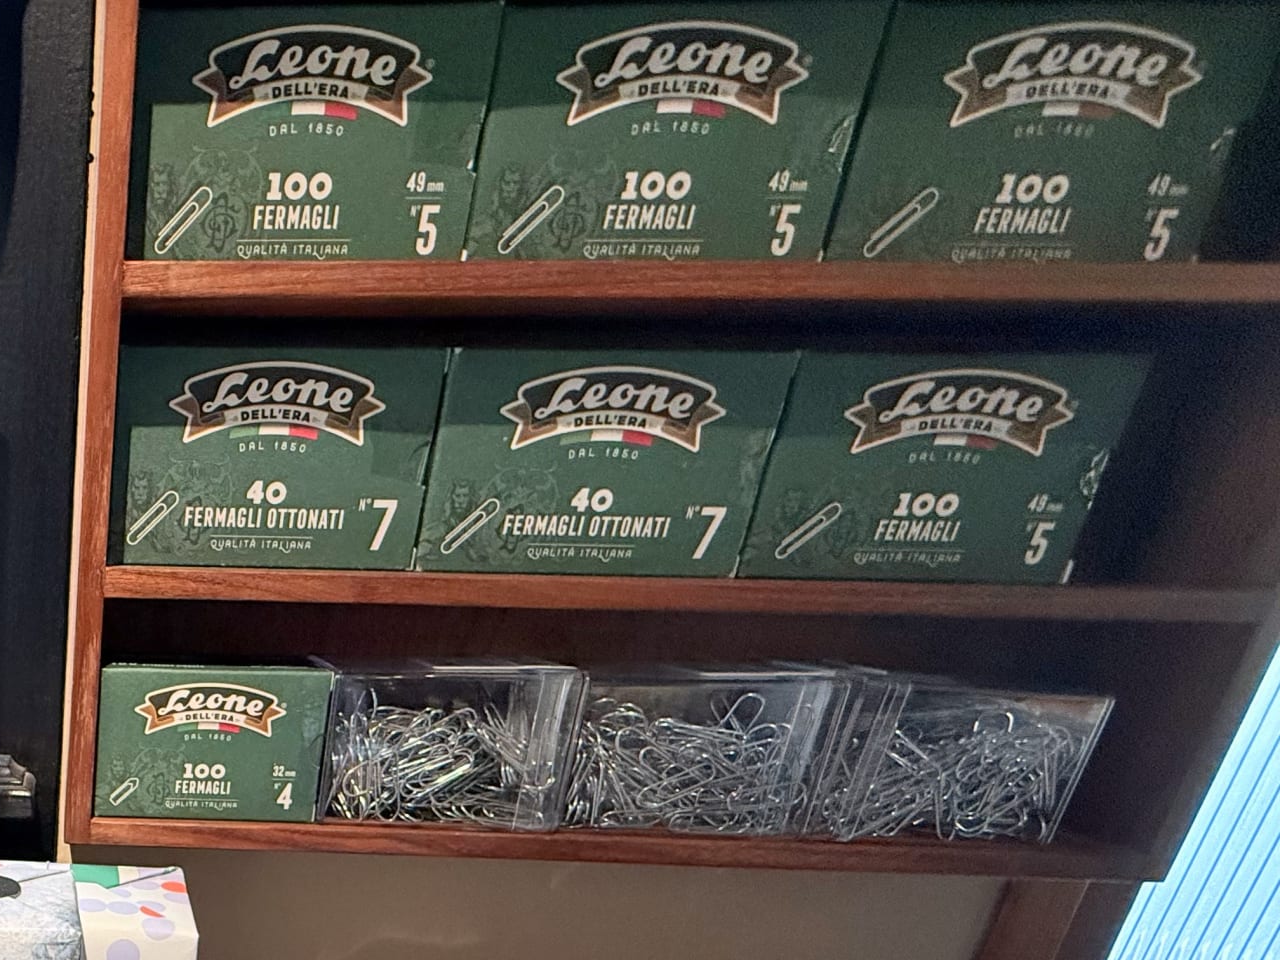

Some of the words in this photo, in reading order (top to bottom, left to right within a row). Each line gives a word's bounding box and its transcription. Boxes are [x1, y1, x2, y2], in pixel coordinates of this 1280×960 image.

[229, 39, 397, 90] Leone
[594, 37, 772, 88] Leone
[982, 37, 1168, 89] Leone
[271, 82, 349, 99] DELL'ERA
[638, 81, 719, 97] DELL'ERA
[1025, 81, 1109, 99] DELL'ERA
[270, 124, 298, 137] DAL
[308, 123, 345, 137] 1850
[631, 121, 660, 136] DAL
[266, 172, 333, 200] 100
[620, 171, 692, 200] 100
[995, 173, 1070, 204] 100
[253, 205, 340, 230] FERMAGLI
[603, 204, 696, 230] FERMAGLI
[973, 207, 1071, 234] FERMAGLI
[237, 242, 287, 259] QUALITÀ
[293, 244, 348, 260] ITALIANA
[583, 242, 636, 260] QUALITÀ
[642, 244, 700, 261] ITALIANA
[202, 372, 353, 413] Leone
[534, 377, 694, 419] Leone
[879, 380, 1043, 423] Leone
[240, 408, 311, 423] DELL'ERA
[573, 414, 647, 429] DELL'ERA
[918, 418, 993, 433] DELL'ERA
[239, 442, 264, 453] DAL
[274, 441, 307, 453] 1850
[568, 449, 596, 460] DAL
[909, 452, 936, 464] DAL
[246, 480, 287, 505] 40
[570, 487, 614, 513] 40
[893, 492, 960, 517] 100
[183, 506, 262, 529] FERMAGLI
[267, 507, 345, 530] OTTONATI
[502, 514, 586, 537] FERMAGLI
[588, 516, 671, 539] OTTONATI
[874, 519, 961, 542] FERMAGLI
[210, 539, 256, 552] QUALITÀ
[261, 540, 311, 554] ITALIANA
[527, 546, 575, 560] QUALITÀ
[579, 548, 633, 563] ITALIANA
[158, 689, 264, 717] Leone
[185, 713, 235, 722] DELL'ERA
[184, 733, 202, 742] DAL
[183, 763, 226, 779] 100
[175, 780, 231, 795] FERMAGLI
[201, 801, 238, 811] ITALIANA
